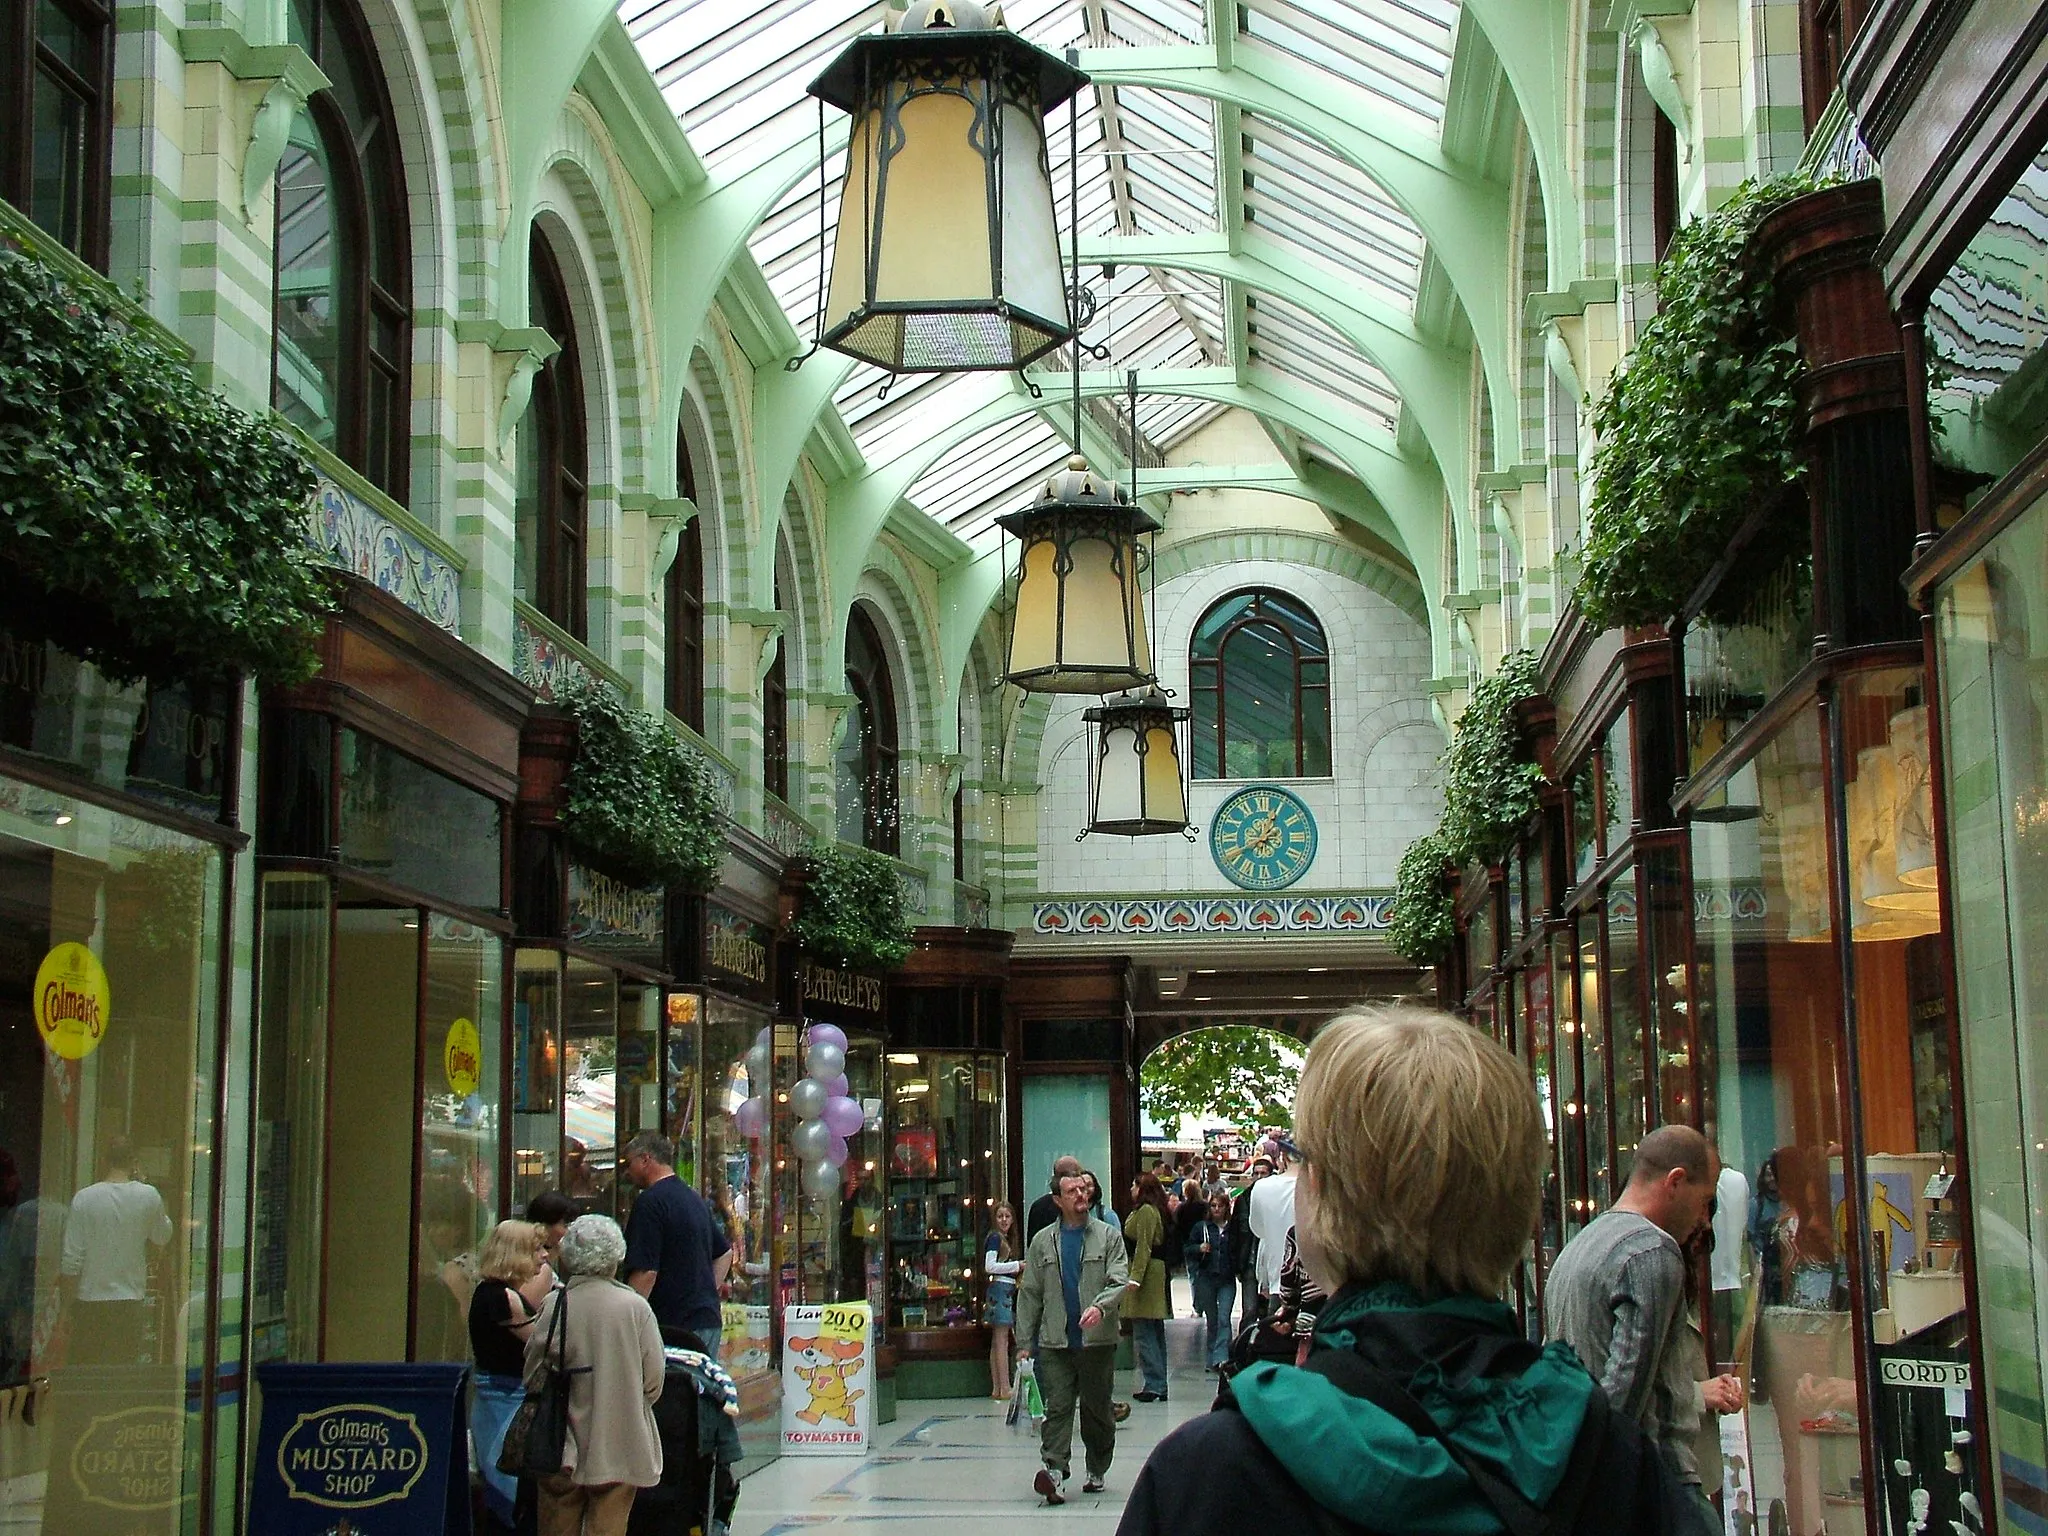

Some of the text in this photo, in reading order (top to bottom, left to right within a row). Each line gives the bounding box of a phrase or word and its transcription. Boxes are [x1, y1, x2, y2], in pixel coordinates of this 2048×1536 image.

[1284, 814, 1300, 827] II
[1289, 832, 1305, 842] III
[708, 925, 766, 982] LANGLEYS
[803, 964, 881, 1012] LANGLEYS
[43, 980, 100, 1038] Colman's
[824, 1309, 865, 1331] 20 Q
[1884, 1362, 1968, 1385] CORD P
[318, 1418, 390, 1446] Colman's
[785, 1431, 863, 1444] TOYMASTER
[292, 1448, 417, 1470] MUSTARD
[324, 1474, 376, 1495] SHOP
